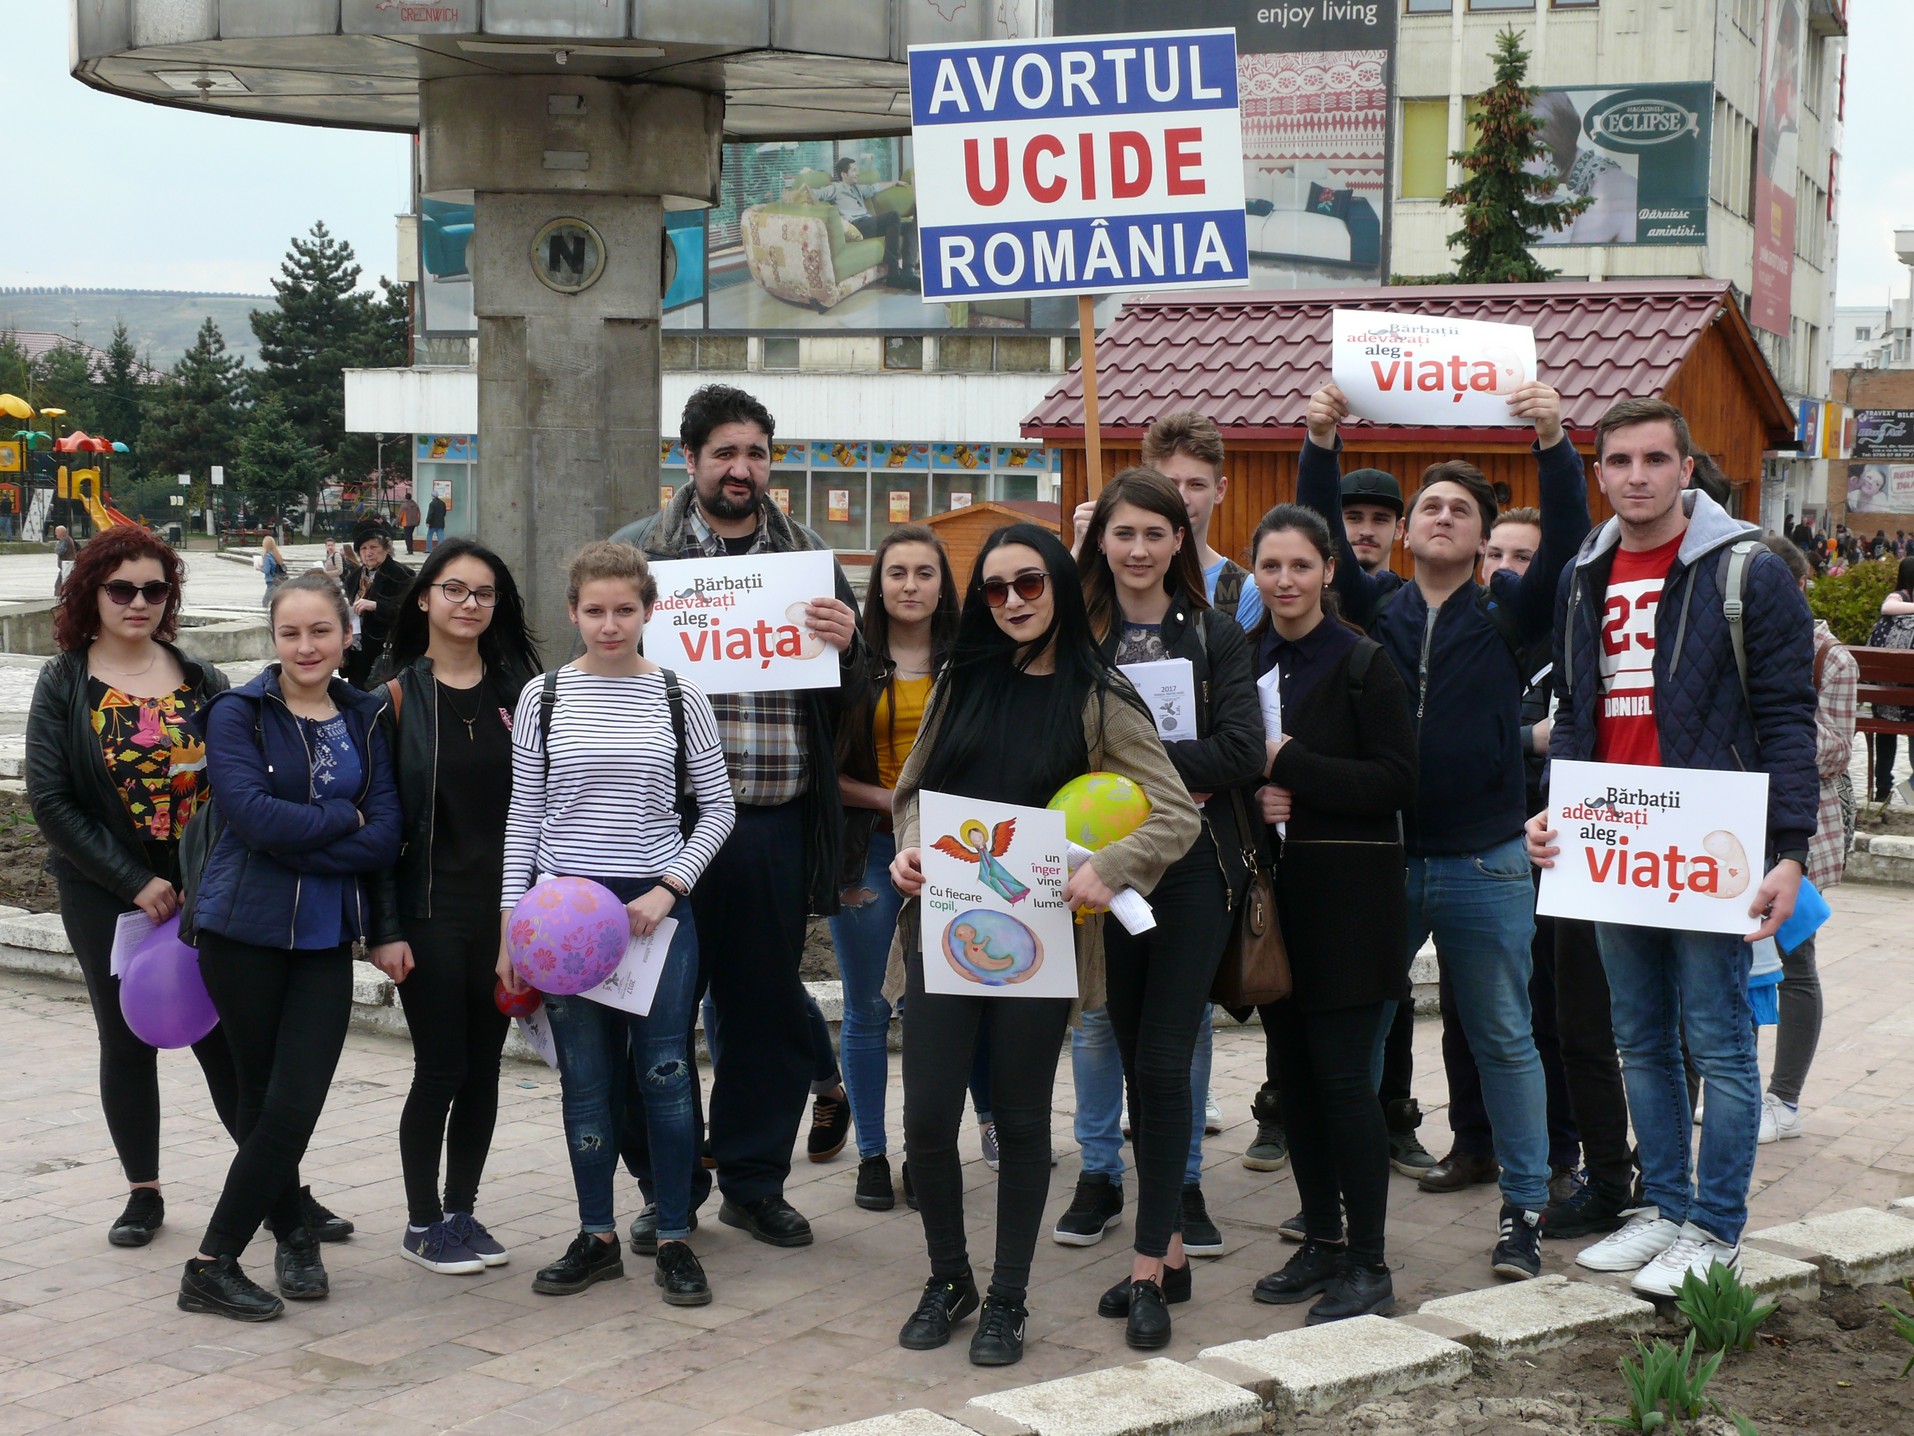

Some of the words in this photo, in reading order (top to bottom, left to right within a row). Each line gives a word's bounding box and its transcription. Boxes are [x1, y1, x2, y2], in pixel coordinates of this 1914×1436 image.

[401, 8, 459, 22] GREENWICH
[1257, 3, 1315, 28] enjoy
[1323, 0, 1378, 25] living
[929, 45, 1222, 114] AVORTUL
[1608, 112, 1681, 132] ECLIPSE
[963, 127, 1206, 207] UCIDE
[549, 235, 585, 274] N
[939, 218, 1234, 289] ROMÂNIA
[1365, 344, 1401, 358] aleg
[1370, 351, 1497, 403] viața
[673, 611, 708, 628] aleg
[679, 617, 802, 669] viața
[1604, 695, 1653, 718] DANIEL
[1580, 823, 1617, 845] aleg
[1045, 855, 1060, 863] un
[1031, 863, 1061, 876] înger
[1584, 835, 1718, 903] viața
[1037, 876, 1062, 887] vine
[929, 885, 943, 896] Cu
[945, 887, 983, 903] fiecare
[1050, 888, 1063, 897] în
[929, 899, 958, 913] copil,
[1033, 899, 1064, 908] lume
[627, 979, 636, 995] 2017
